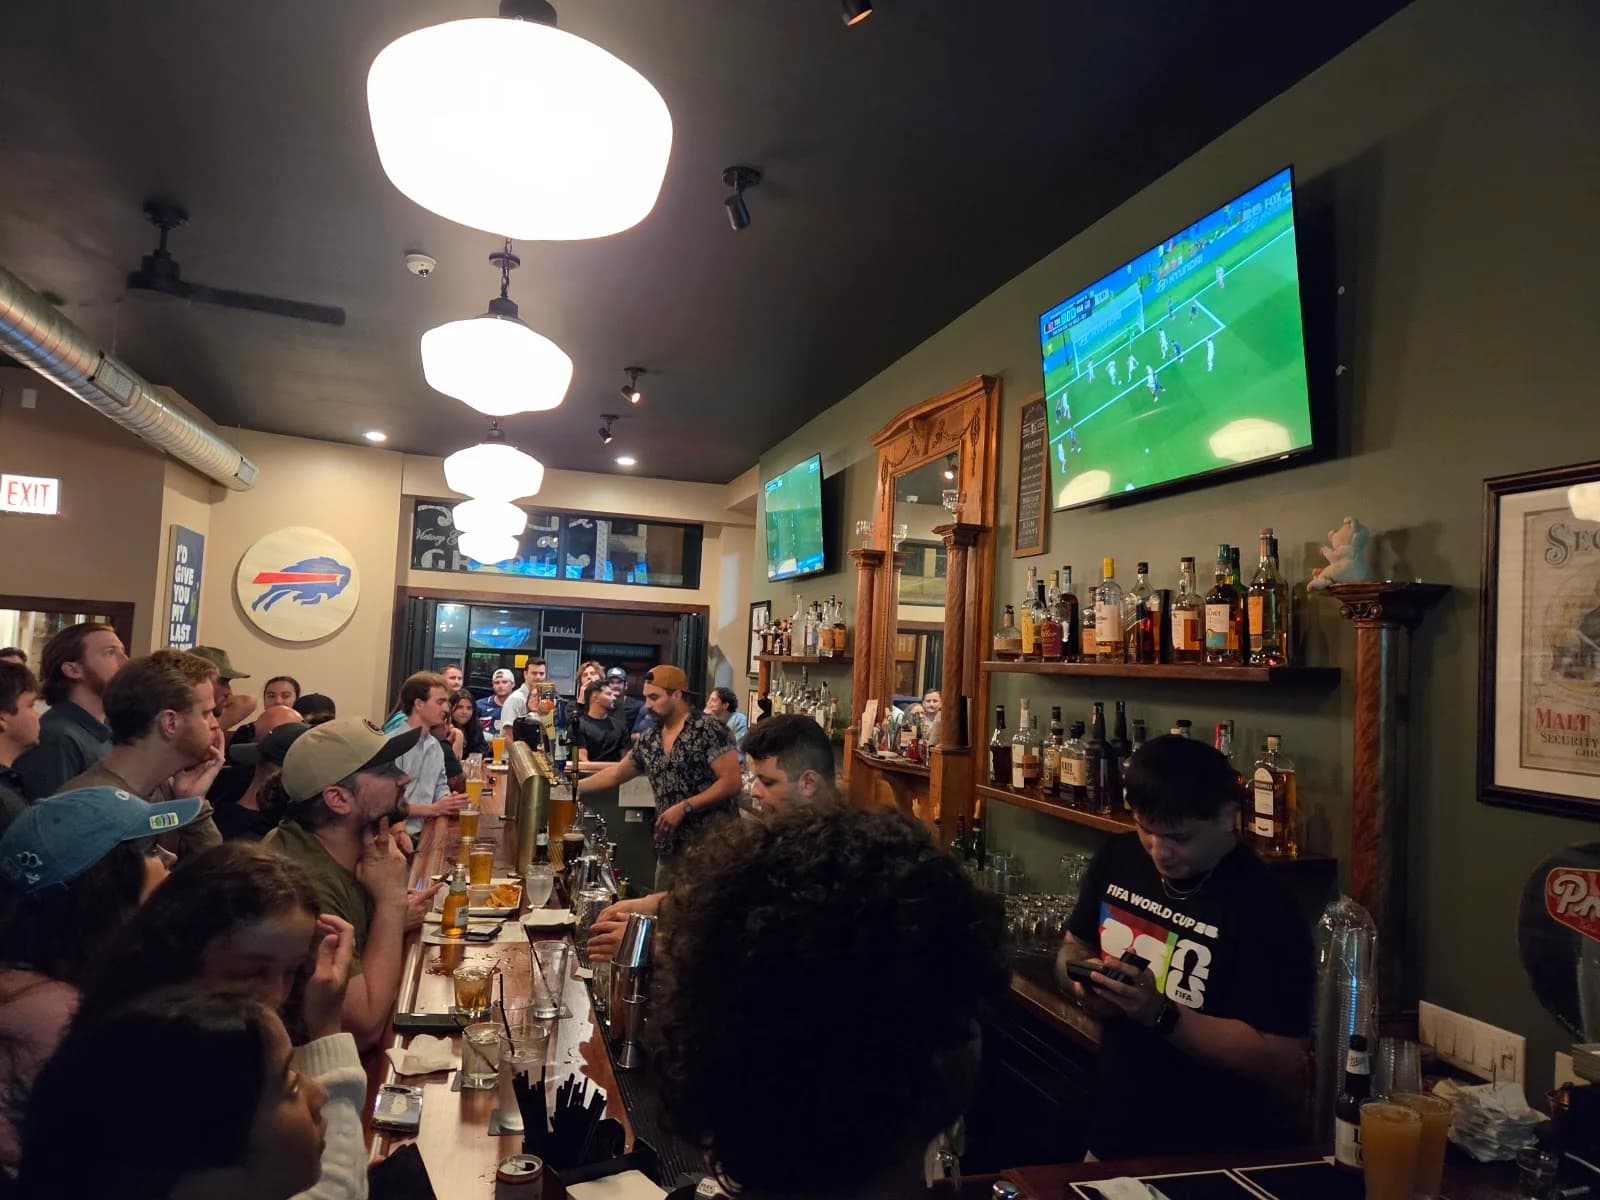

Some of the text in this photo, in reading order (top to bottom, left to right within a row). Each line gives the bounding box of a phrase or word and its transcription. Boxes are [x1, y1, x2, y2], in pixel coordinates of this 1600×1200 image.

[1167, 255, 1203, 283] HYUNDAI
[7, 480, 51, 508] EXIT
[177, 545, 188, 562] I'D
[175, 564, 194, 585] GIVE
[174, 584, 190, 604] YOU
[172, 604, 185, 622] MY
[170, 623, 191, 642] LAST
[1536, 707, 1591, 732] MALT
[1540, 731, 1599, 749] SECURITY
[1107, 884, 1128, 901] FIFA
[1130, 893, 1171, 919] WORLD
[1172, 912, 1195, 928] CUP
[1174, 989, 1193, 1002] FIFA
